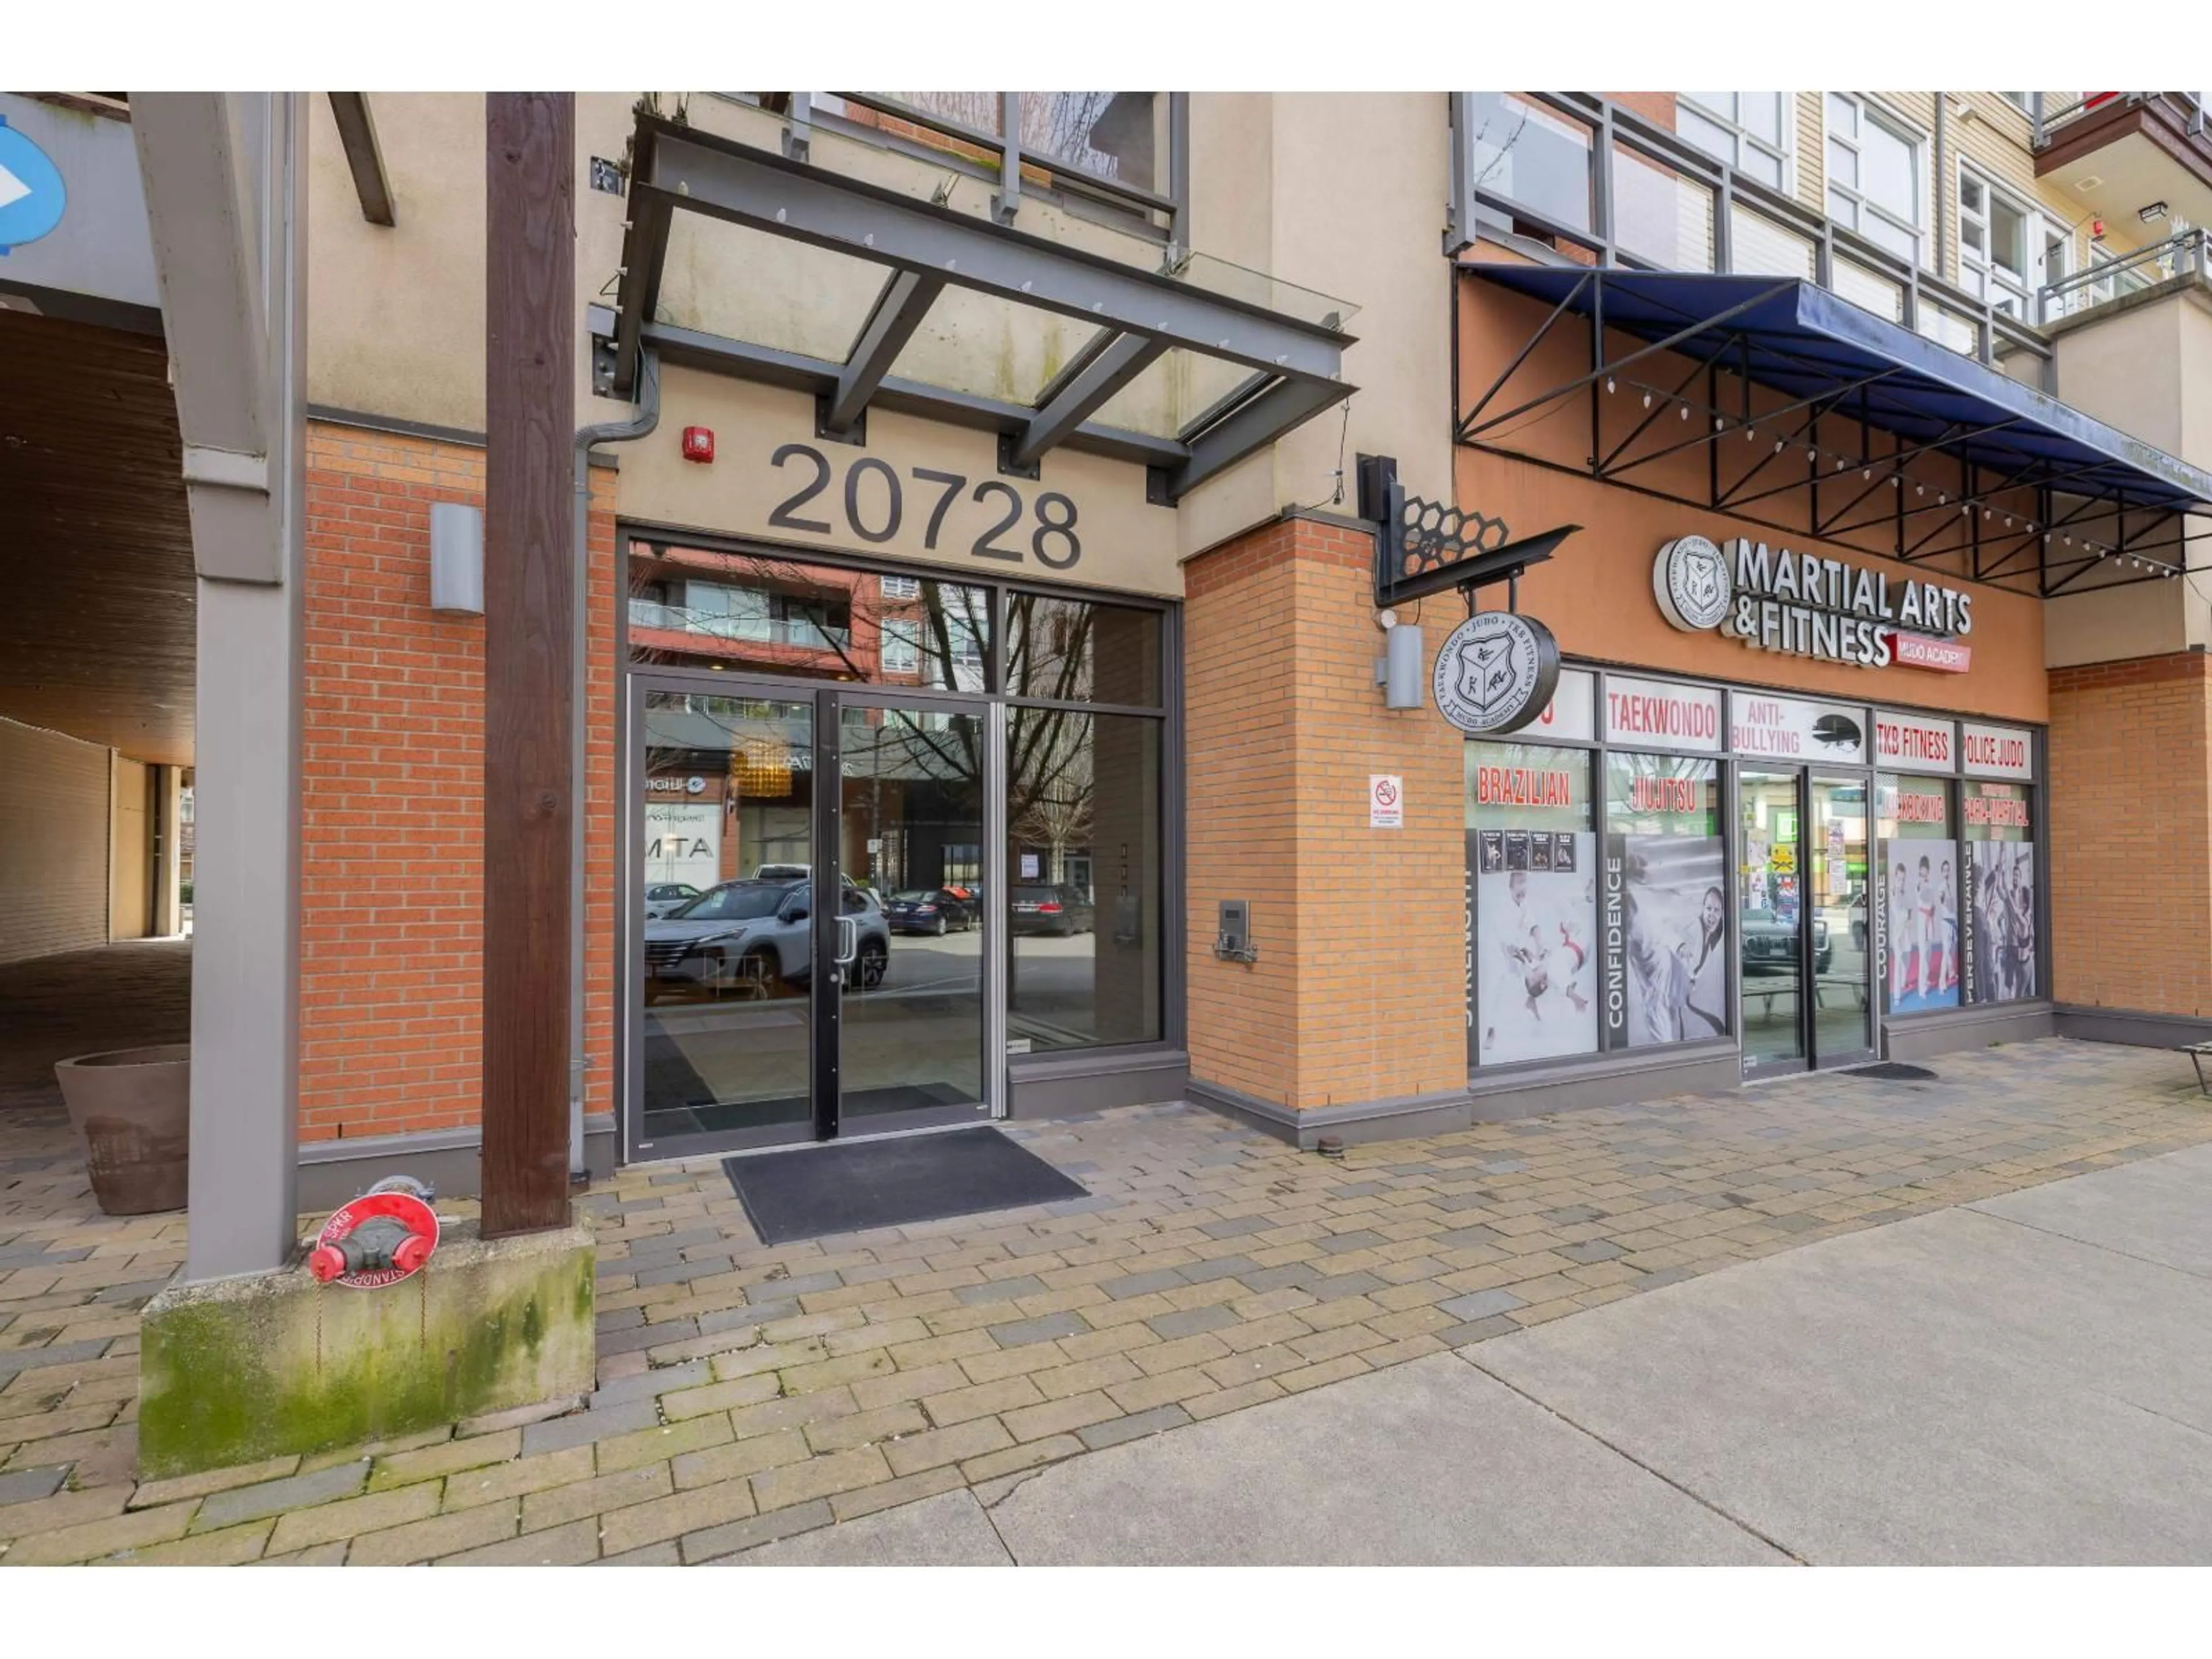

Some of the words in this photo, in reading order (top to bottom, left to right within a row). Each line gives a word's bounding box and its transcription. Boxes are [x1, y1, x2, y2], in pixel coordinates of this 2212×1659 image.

[768, 443, 1081, 570] 20728
[1736, 537, 1893, 619] MARTIAL
[1899, 579, 1971, 634] ARTS
[1472, 616, 1498, 632] JUDO
[1608, 692, 1716, 740] TAEKWONDO
[1732, 725, 1800, 753] BULLYING
[1876, 723, 1899, 755] TKB
[1902, 726, 1948, 761] FITNESS
[1998, 738, 2024, 768] JUDO
[1478, 764, 1571, 806] BRAZILIAN
[1631, 777, 1696, 813] JIUJITSU
[1608, 857, 1623, 1028] CONFIDENCE
[1877, 873, 1887, 979] COURAGE
